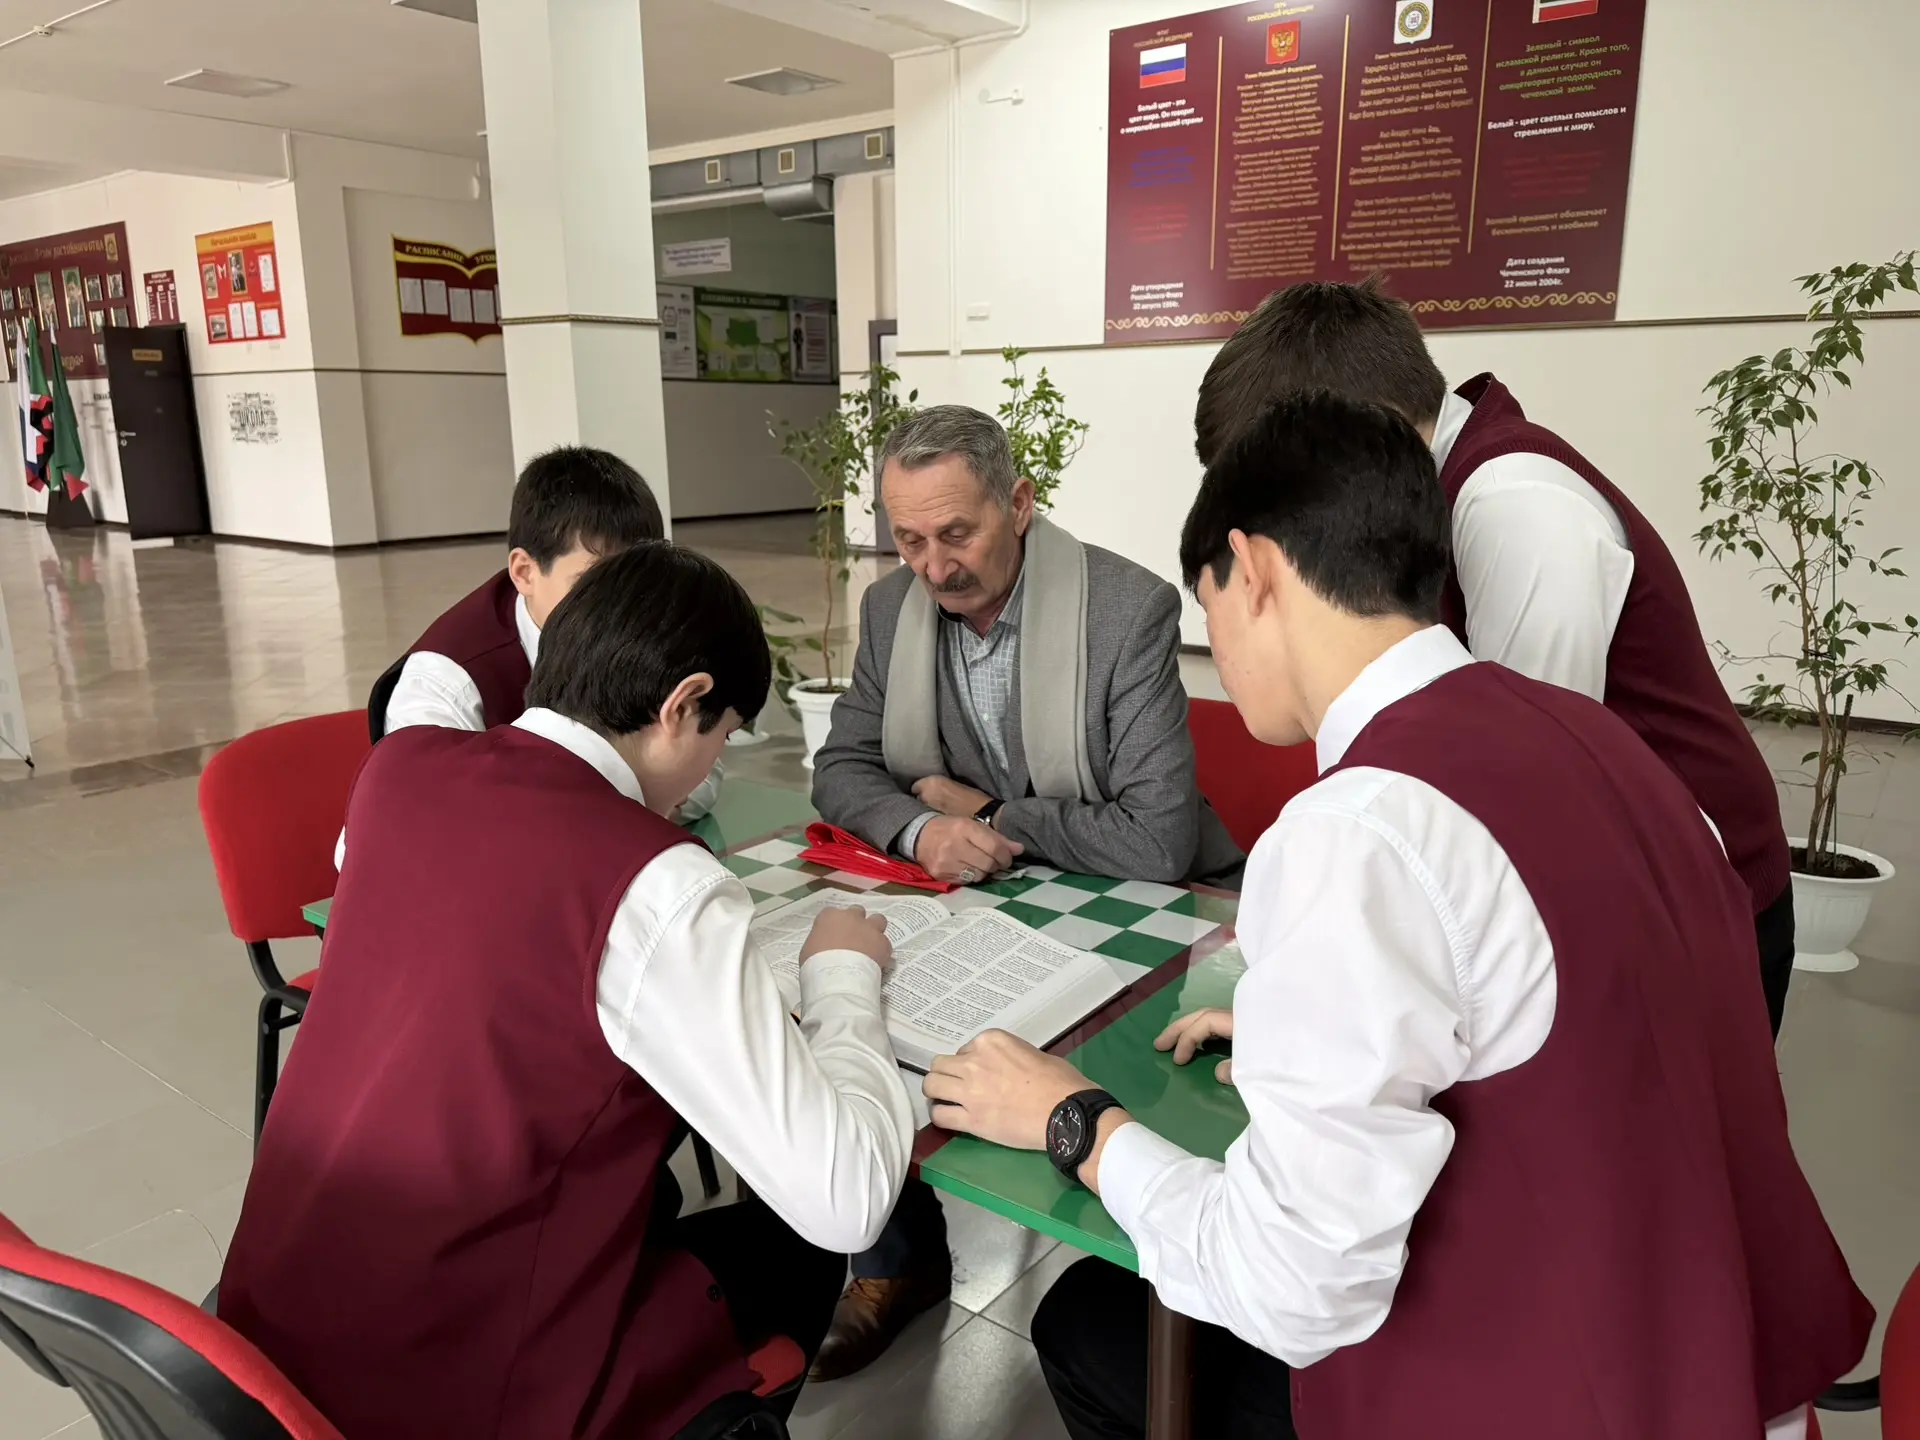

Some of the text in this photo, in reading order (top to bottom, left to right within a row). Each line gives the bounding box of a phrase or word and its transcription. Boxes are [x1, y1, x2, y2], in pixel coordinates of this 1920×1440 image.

[1526, 40, 1562, 52] Зеленый
[1568, 36, 1600, 46] символ
[1496, 43, 1630, 68] исламской религии. Кроме того,
[1526, 66, 1559, 76] данном
[1561, 60, 1589, 71] случае
[1557, 68, 1622, 83] плодородность
[1520, 84, 1596, 99] чеченской земли.
[1488, 119, 1514, 130] Белый
[1520, 117, 1539, 126] цвет
[1540, 114, 1573, 123] светлых
[1574, 108, 1619, 118] помыслов
[1514, 126, 1562, 138] стремления
[1571, 122, 1595, 131] миру.
[1506, 256, 1565, 267] Дата создания
[1500, 267, 1570, 277] Чеченского Флага
